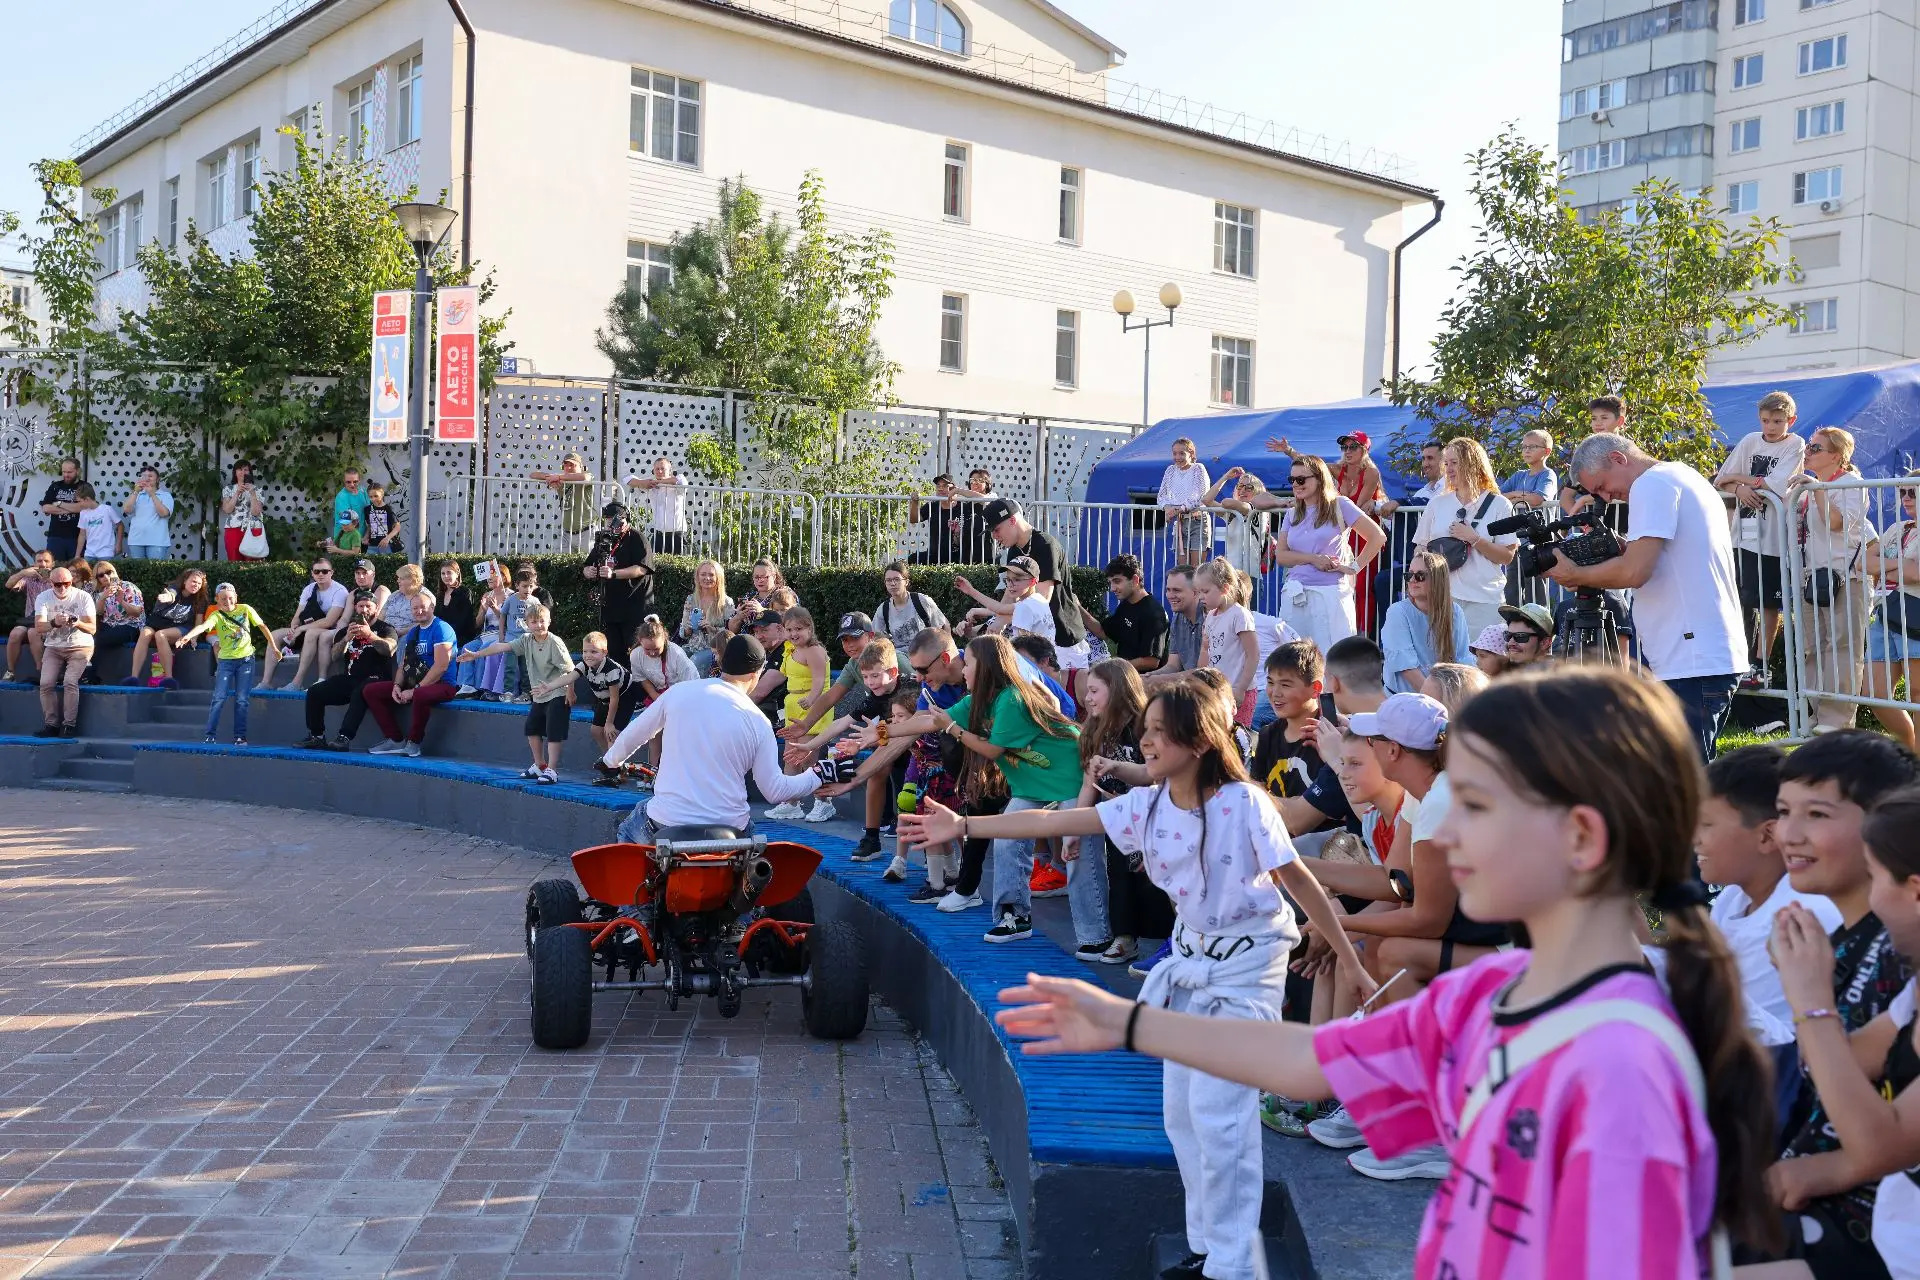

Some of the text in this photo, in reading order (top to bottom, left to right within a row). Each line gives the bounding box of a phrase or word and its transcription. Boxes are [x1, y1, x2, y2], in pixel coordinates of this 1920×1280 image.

[382, 319, 401, 328] ЛЕТО
[503, 360, 516, 371] 34
[446, 346, 460, 405] ЛЕТО
